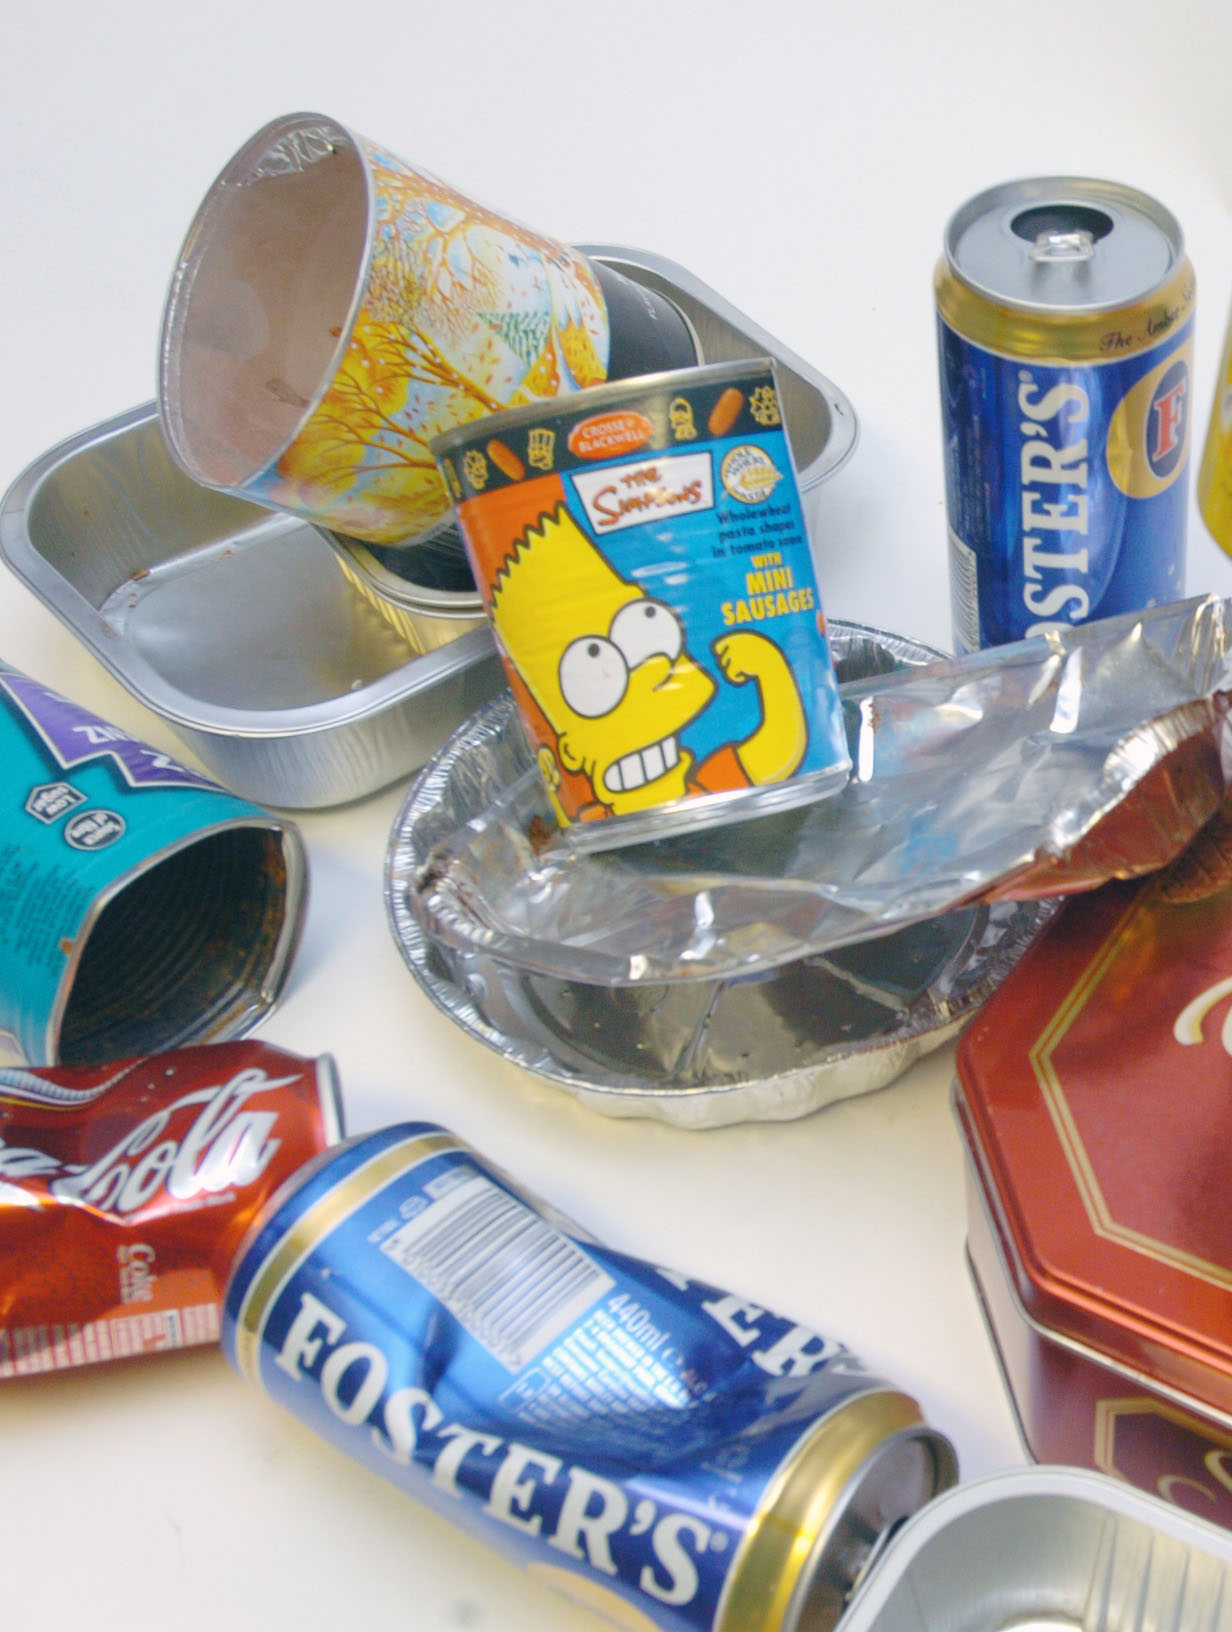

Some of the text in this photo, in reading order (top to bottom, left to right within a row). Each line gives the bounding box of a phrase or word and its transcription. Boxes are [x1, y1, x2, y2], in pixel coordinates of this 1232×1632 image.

[1151, 383, 1187, 463] F
[620, 465, 662, 489] THE
[1017, 378, 1091, 640] STER'S
[712, 545, 727, 559] in
[730, 537, 776, 554] tomato
[718, 525, 756, 545] pasta
[751, 551, 783, 569] WITH
[746, 565, 795, 596] MINI
[721, 586, 815, 627] SAUSAGES
[607, 1292, 671, 1352] 440ml
[274, 1292, 705, 1608] FOSTER'S
